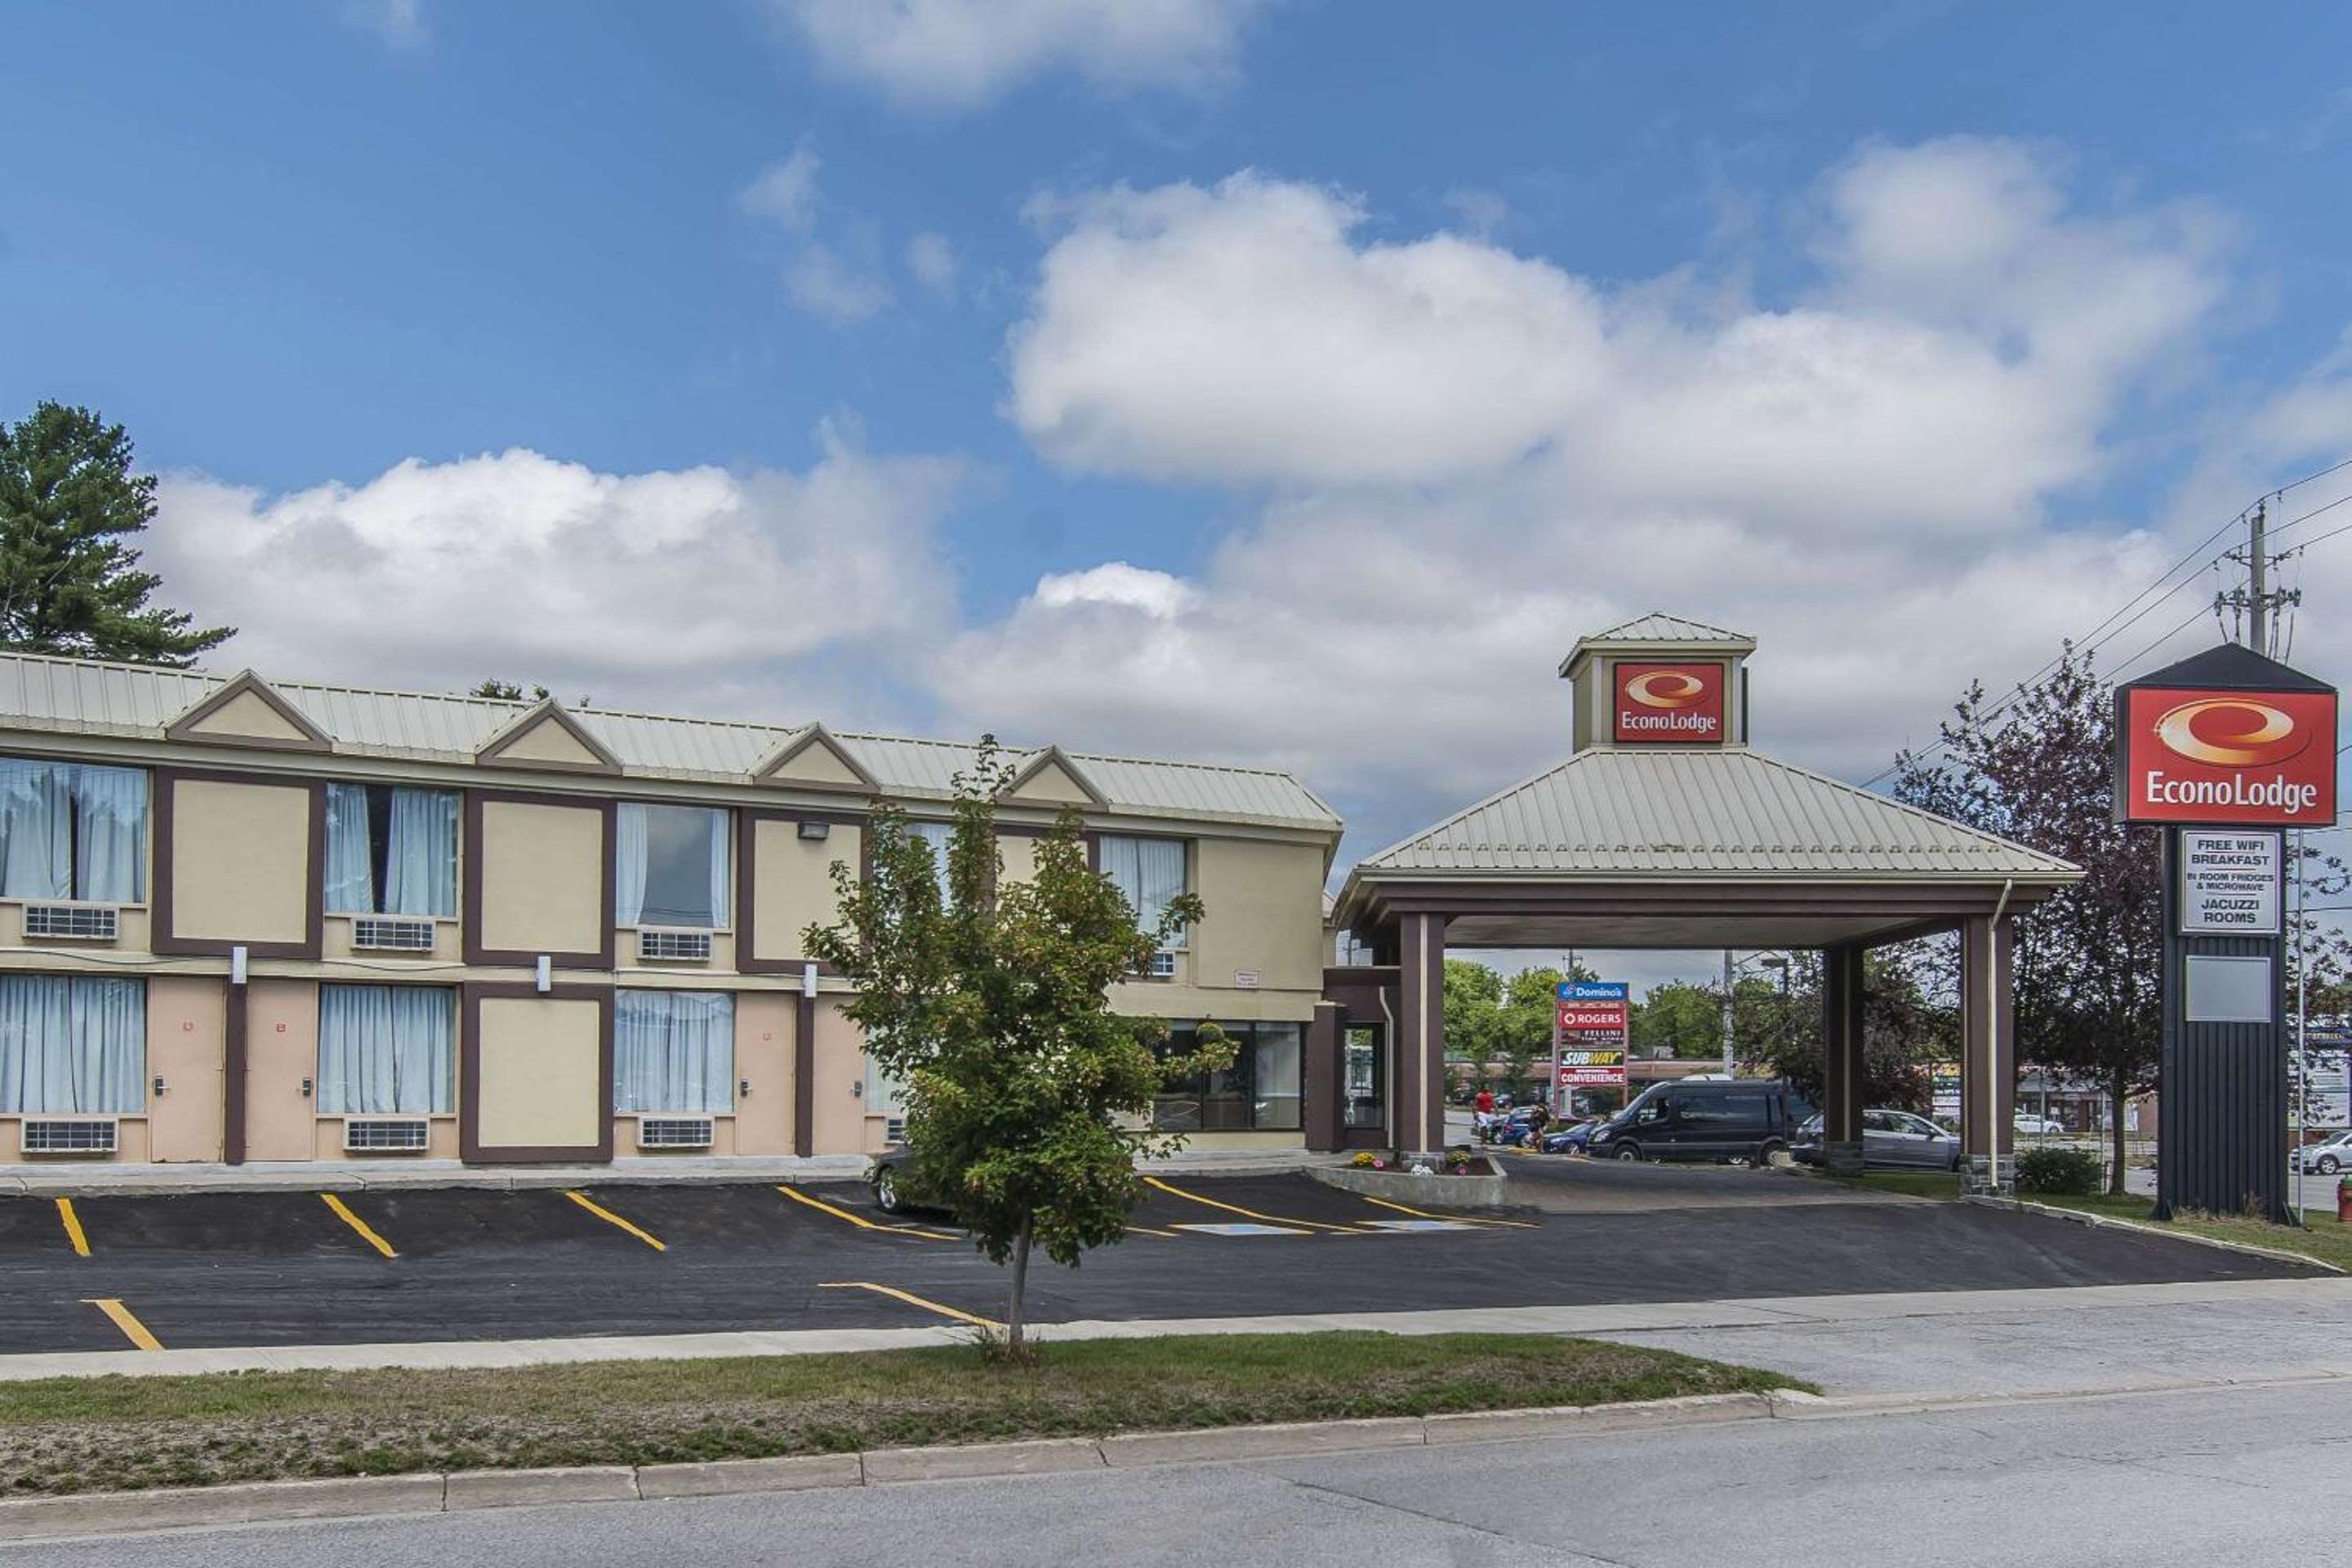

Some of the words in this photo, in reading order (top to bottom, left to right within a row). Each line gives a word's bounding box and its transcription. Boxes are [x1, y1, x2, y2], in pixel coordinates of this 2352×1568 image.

[1622, 711, 1716, 733] EconoLodge
[2147, 771, 2317, 814] EconoLodge
[2198, 840, 2233, 850] FREE
[2236, 840, 2265, 851] WIFI
[2191, 854, 2270, 866] BREAKFAST
[2231, 874, 2274, 882] FRIDGES
[2196, 882, 2203, 890] &
[2206, 883, 2265, 891] MICROWAVE
[2201, 899, 2260, 910] JACUZZI
[2204, 912, 2256, 924] ROOMS
[1576, 987, 1622, 996] Domino's
[1577, 1014, 1621, 1023] ROGERS
[1562, 1052, 1622, 1065] SUBWAY
[1561, 1074, 1624, 1083] CONVENIENCE
